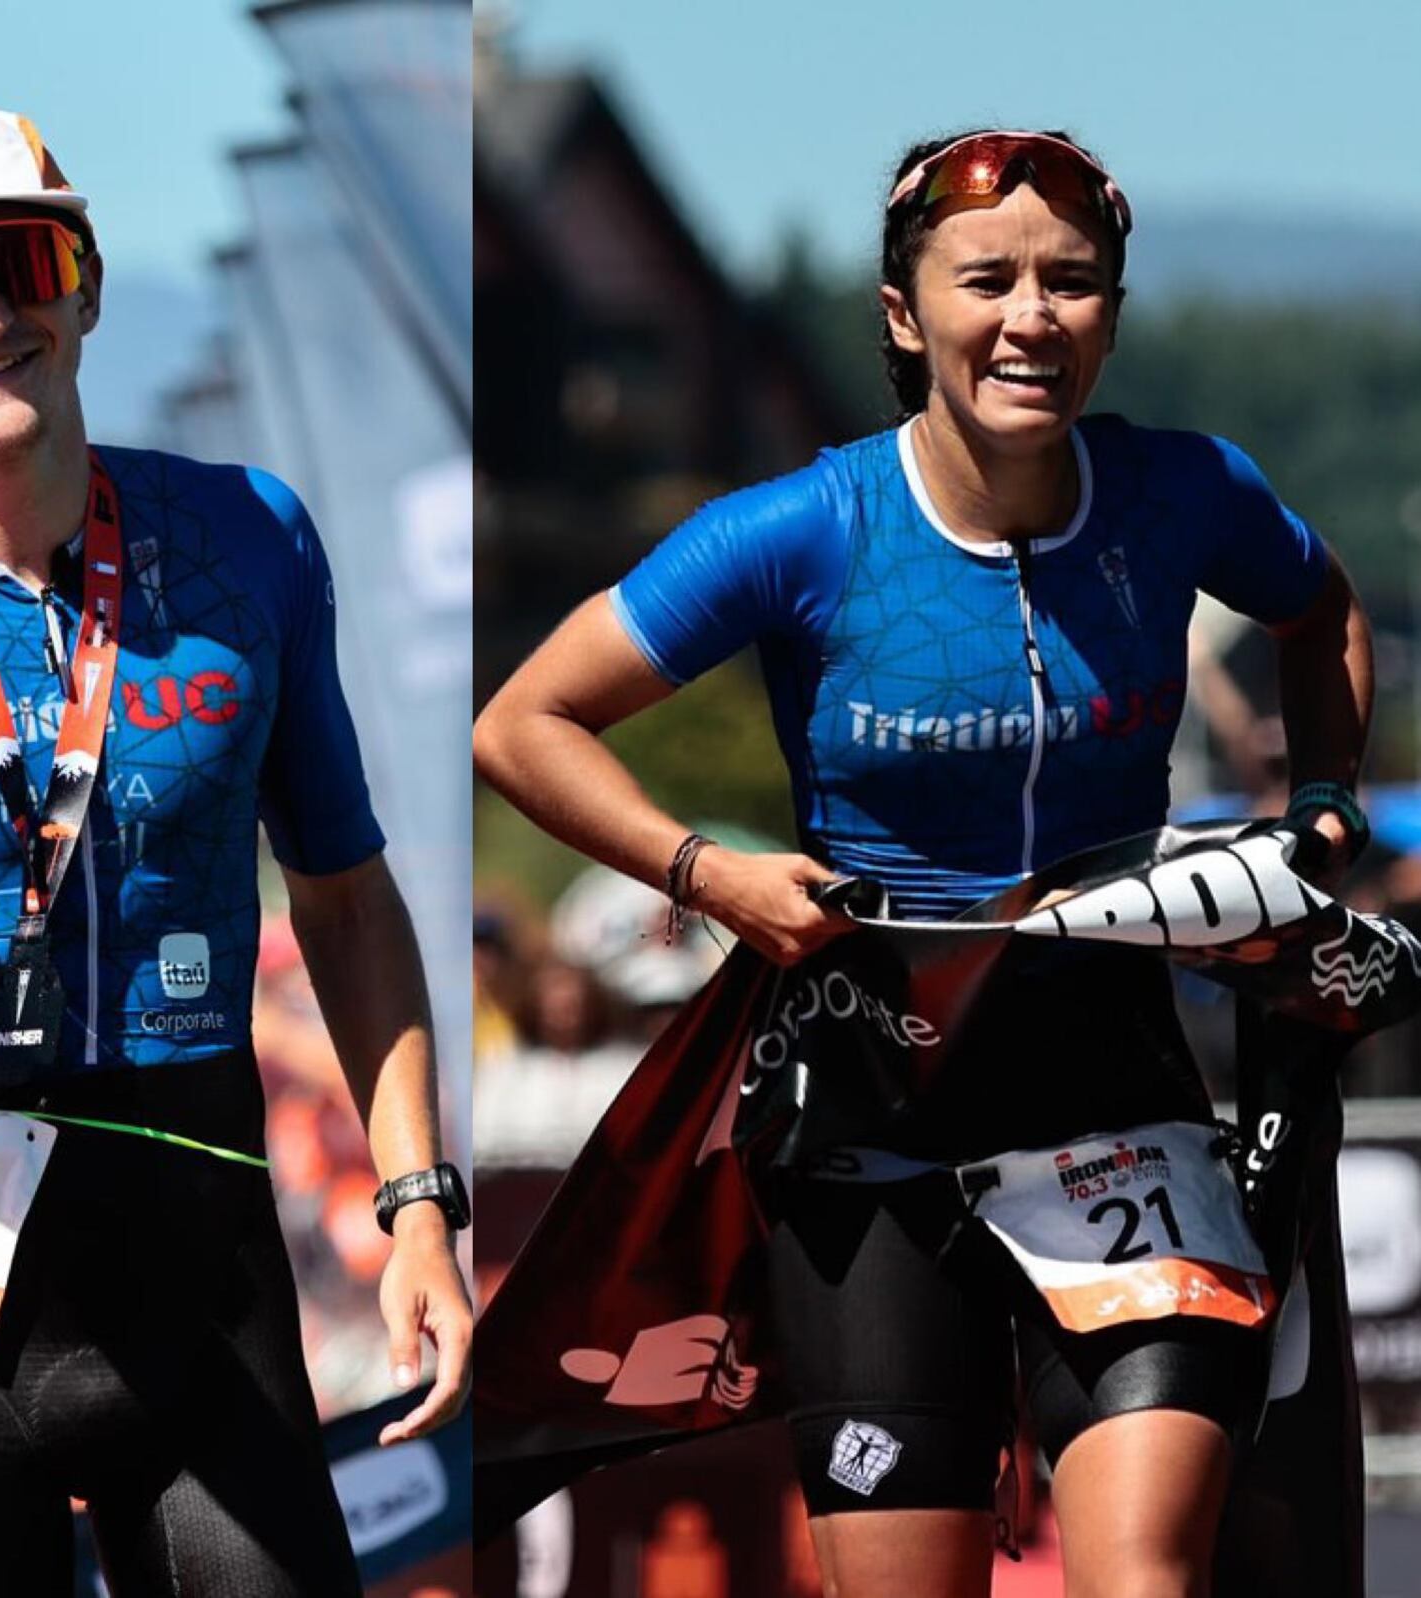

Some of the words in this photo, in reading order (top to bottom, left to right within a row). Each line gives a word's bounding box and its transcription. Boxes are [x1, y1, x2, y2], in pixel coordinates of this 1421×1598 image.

[121, 671, 239, 730] UC
[141, 1009, 226, 1034] Corporate
[1058, 1141, 1170, 1188] IRONMAN
[1064, 1177, 1109, 1203] 70.3
[1087, 1184, 1184, 1265] 21
